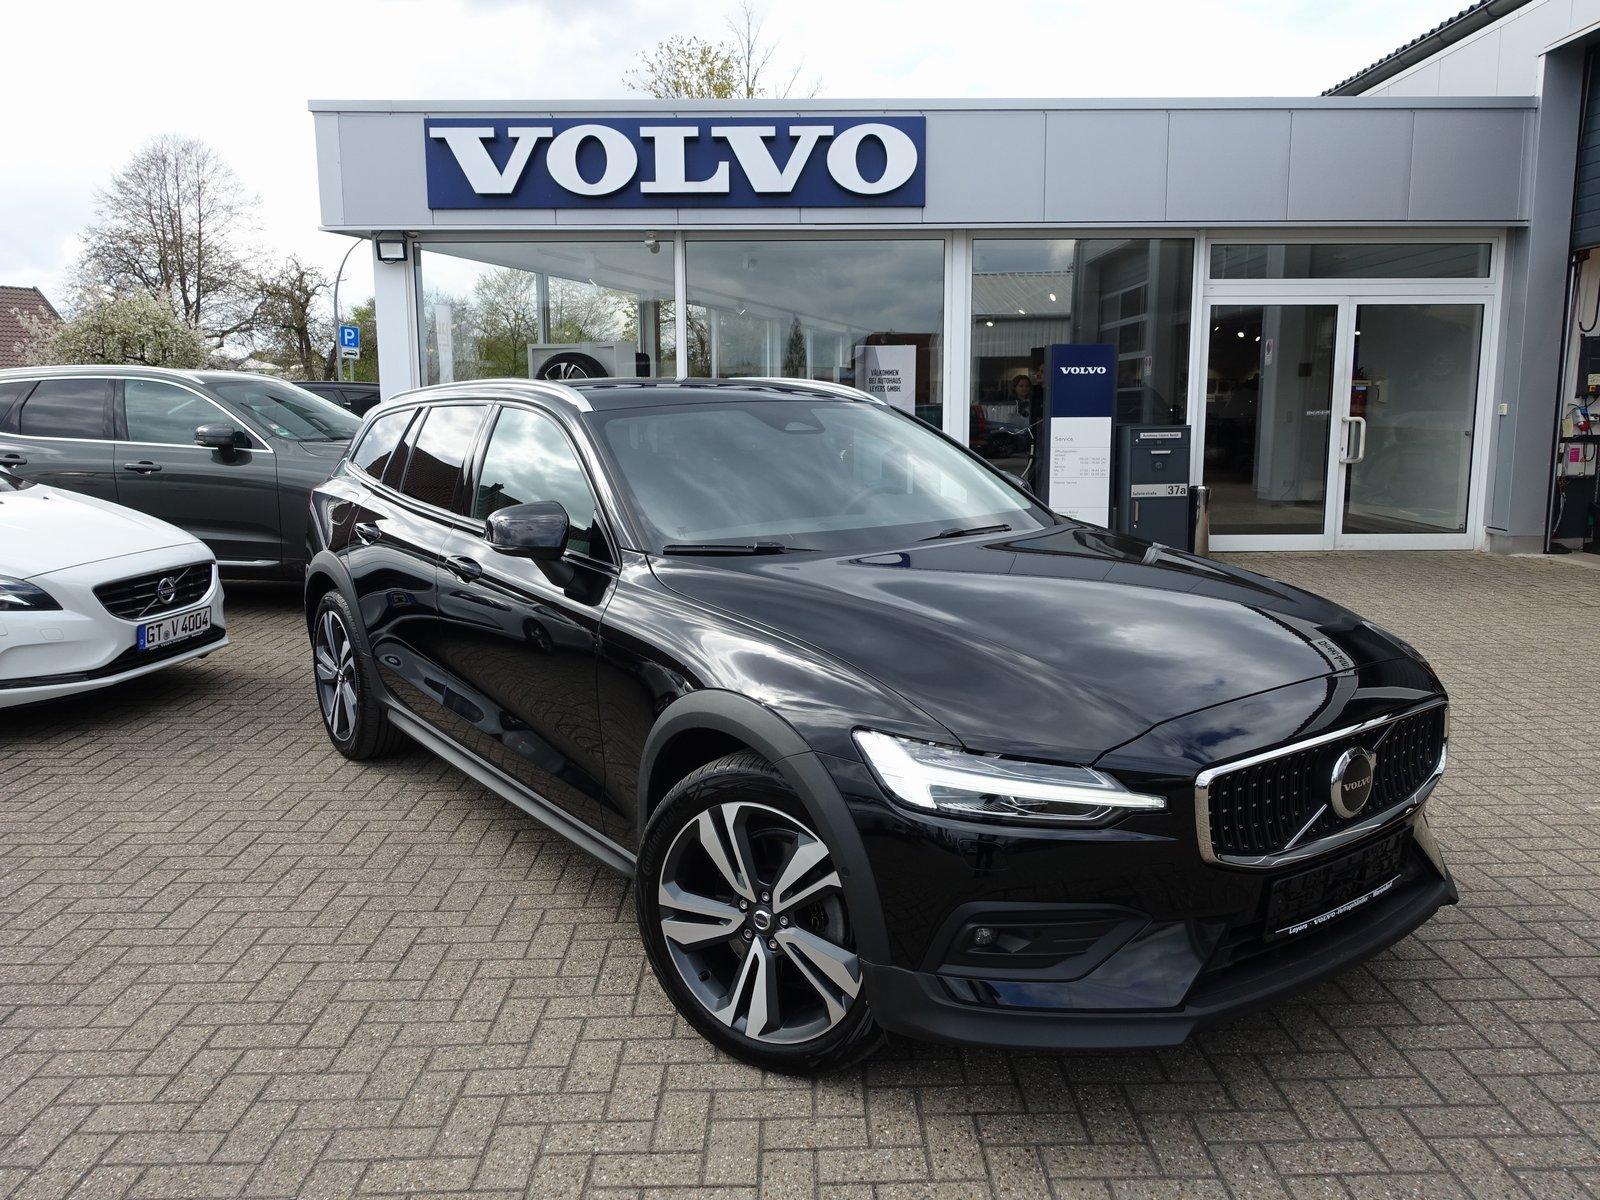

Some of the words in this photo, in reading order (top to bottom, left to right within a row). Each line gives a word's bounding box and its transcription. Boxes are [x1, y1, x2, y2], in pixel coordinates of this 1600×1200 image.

[429, 123, 918, 196] VOLVO
[344, 329, 354, 345] P
[1060, 366, 1106, 374] VOLVO
[1167, 485, 1186, 495] 37a
[146, 624, 163, 644] GT
[172, 620, 179, 636] V
[182, 610, 208, 632] 4004
[1343, 776, 1371, 792] VOLVO
